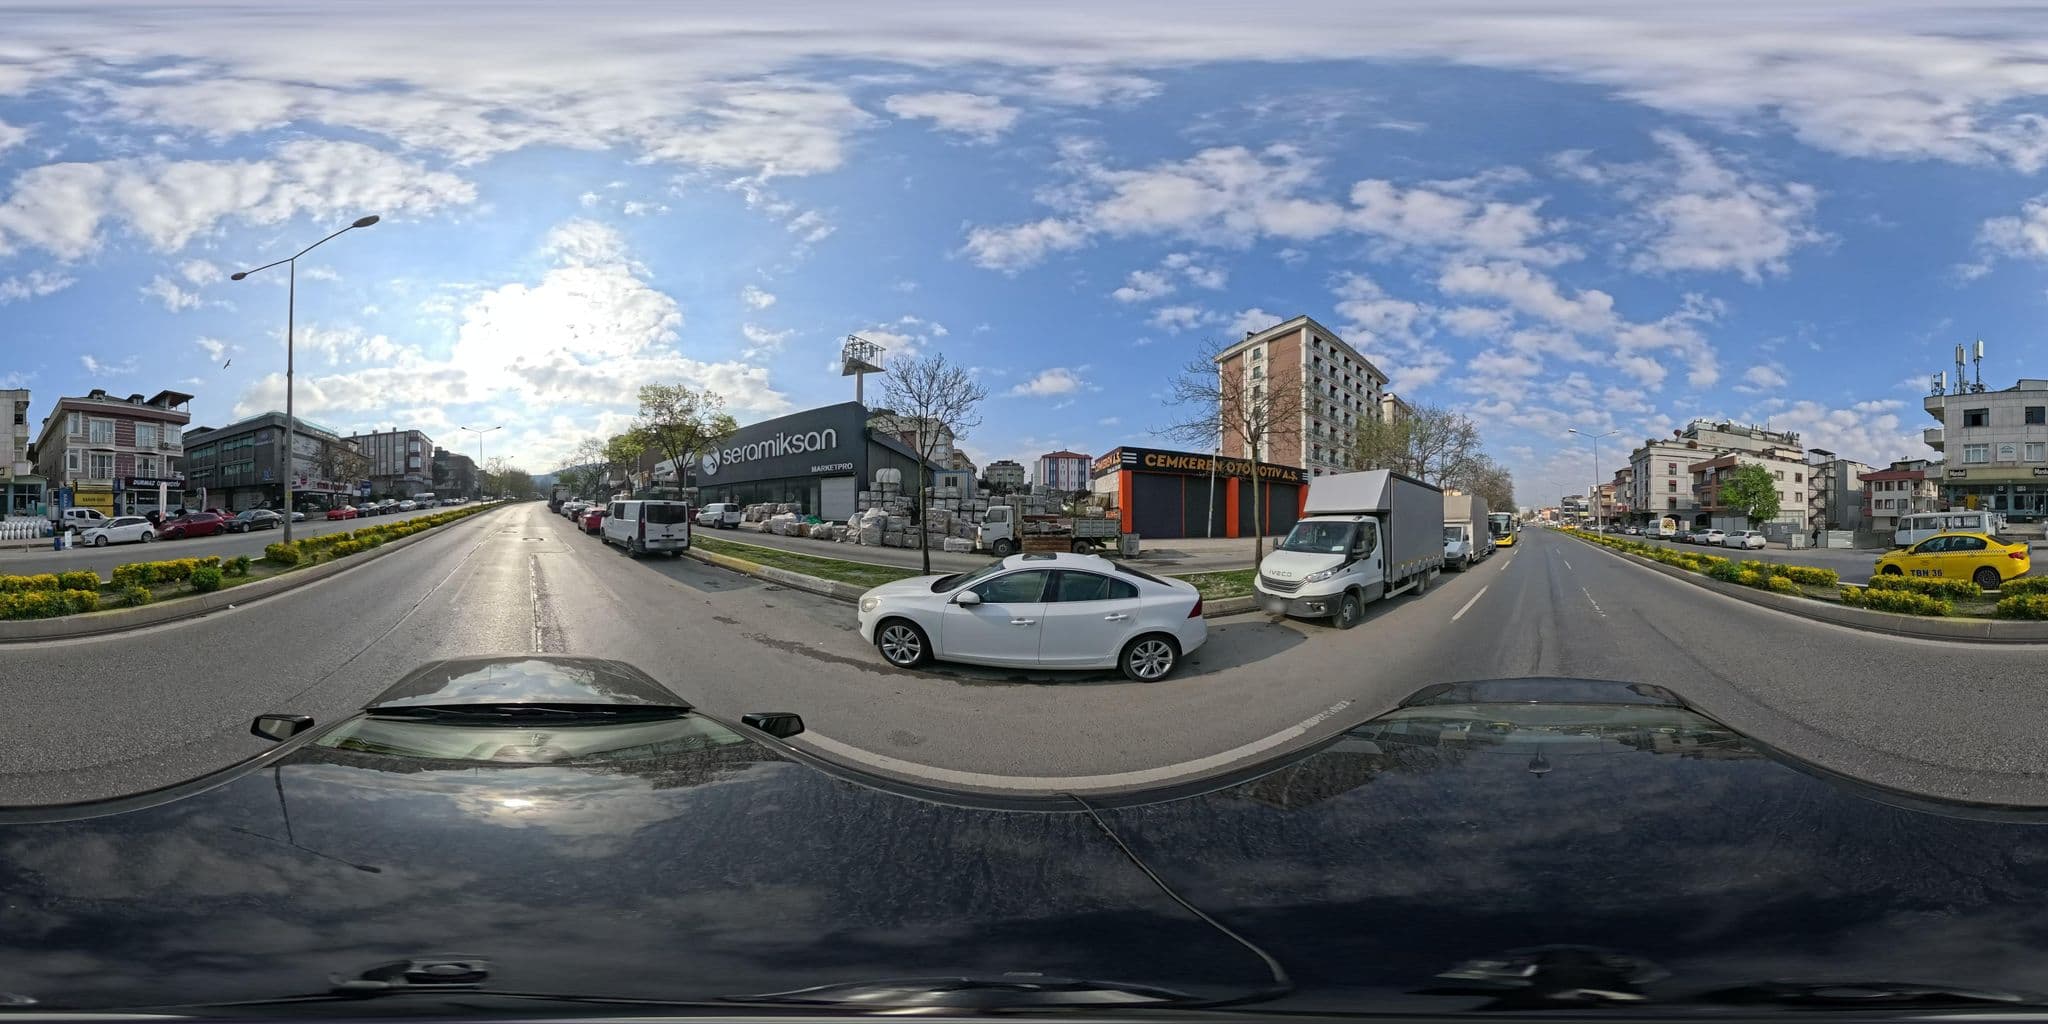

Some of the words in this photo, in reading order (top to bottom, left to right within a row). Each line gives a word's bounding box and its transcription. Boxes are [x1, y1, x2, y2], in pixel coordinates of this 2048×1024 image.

[722, 428, 837, 465] seramiksan
[811, 462, 853, 473] MARKETPRO
[1144, 453, 1222, 471] CEMKEREN
[1269, 569, 1292, 577] IVECO
